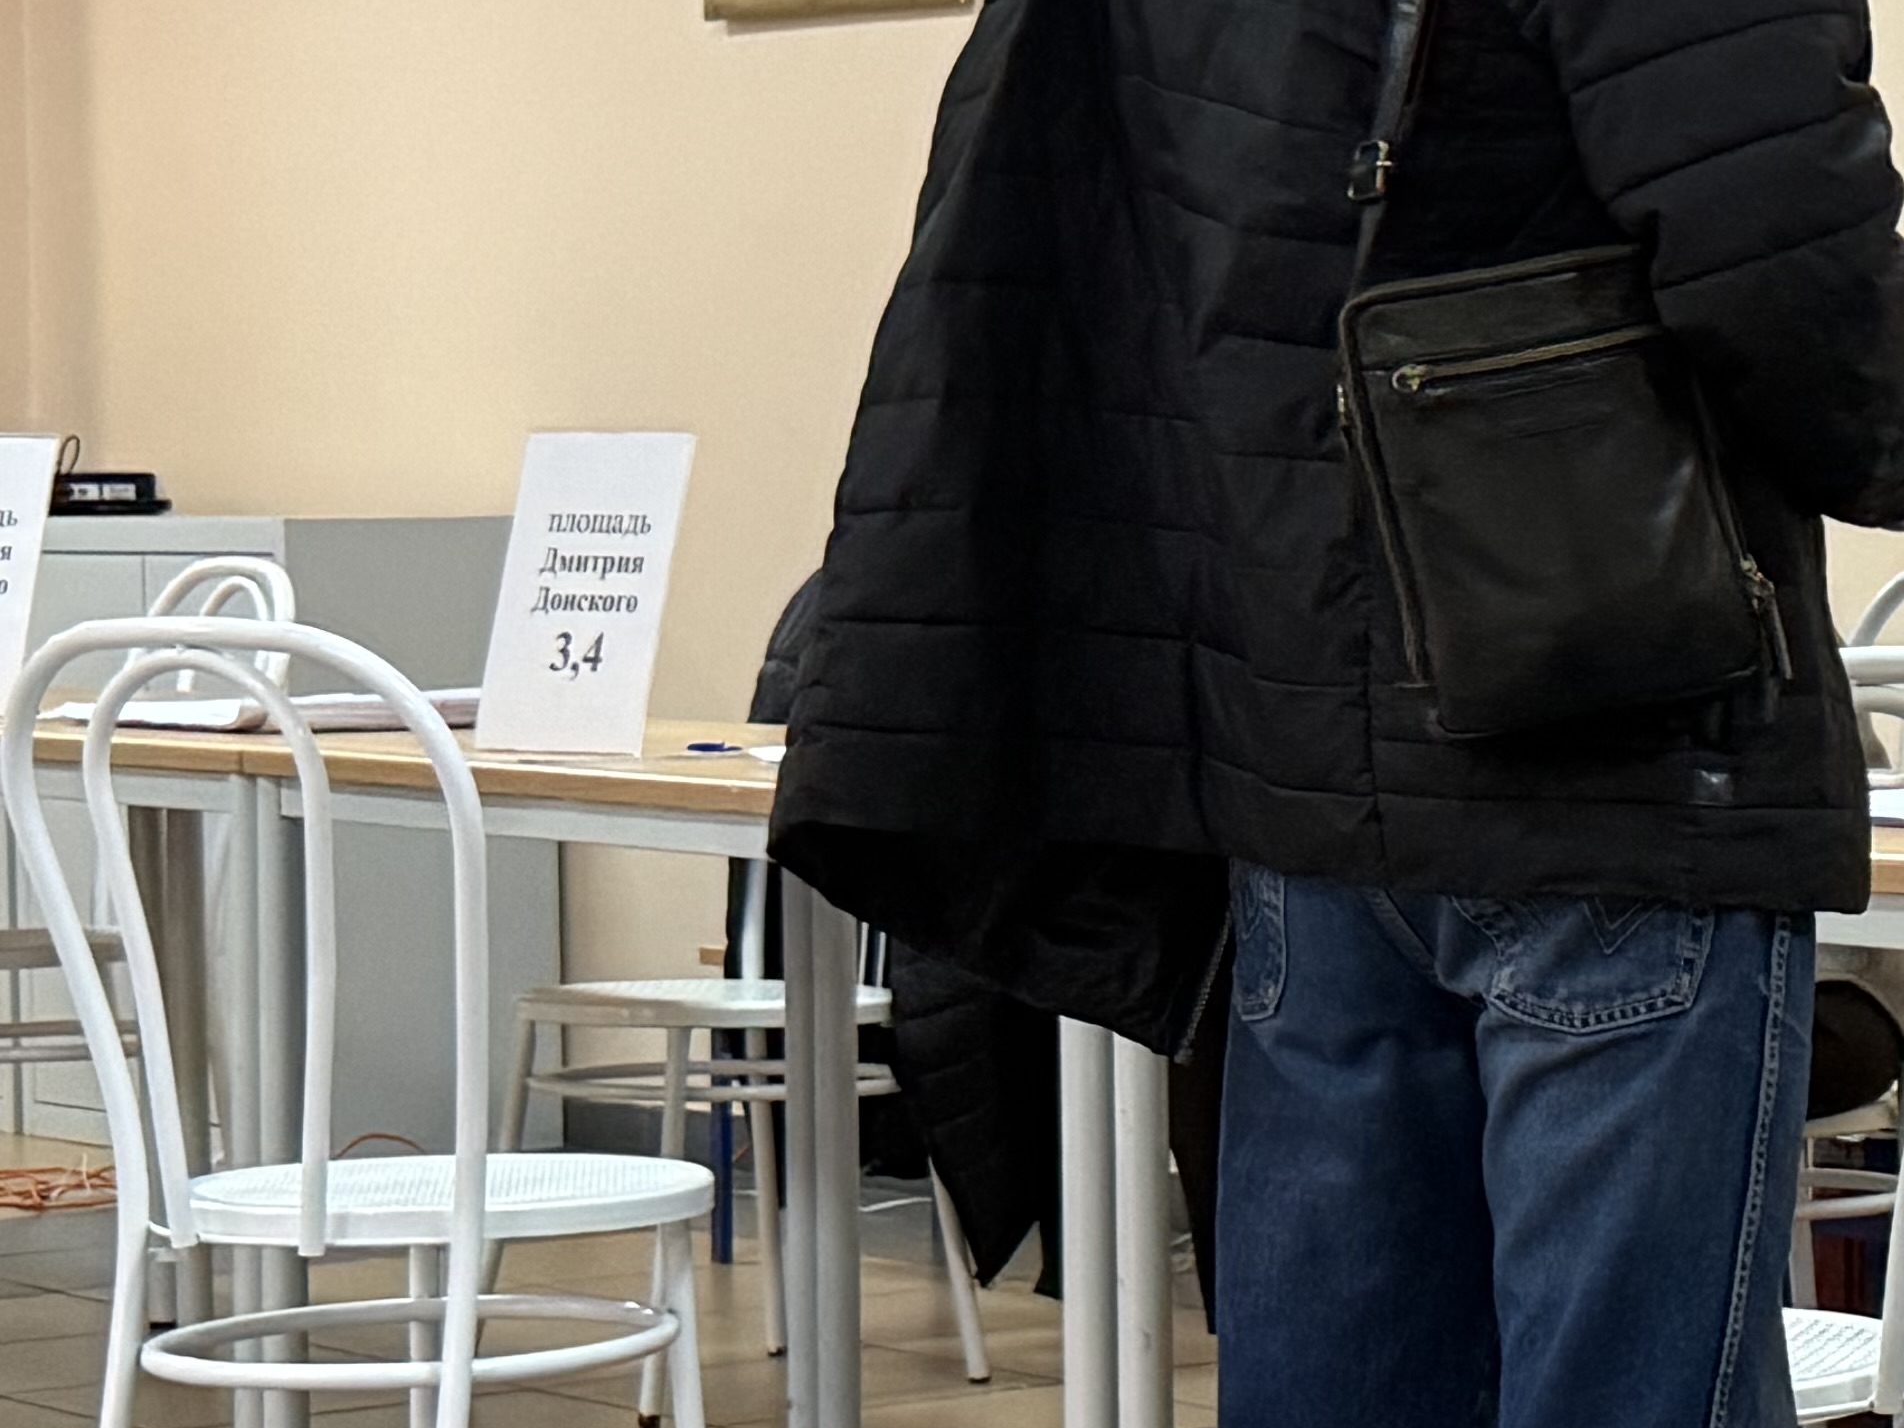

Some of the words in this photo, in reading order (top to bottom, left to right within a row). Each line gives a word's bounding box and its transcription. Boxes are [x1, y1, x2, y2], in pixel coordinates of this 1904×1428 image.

[548, 513, 652, 536] площадь
[539, 547, 645, 581] Дмитрия
[530, 586, 638, 615] Донского
[549, 631, 604, 681] 3,4
